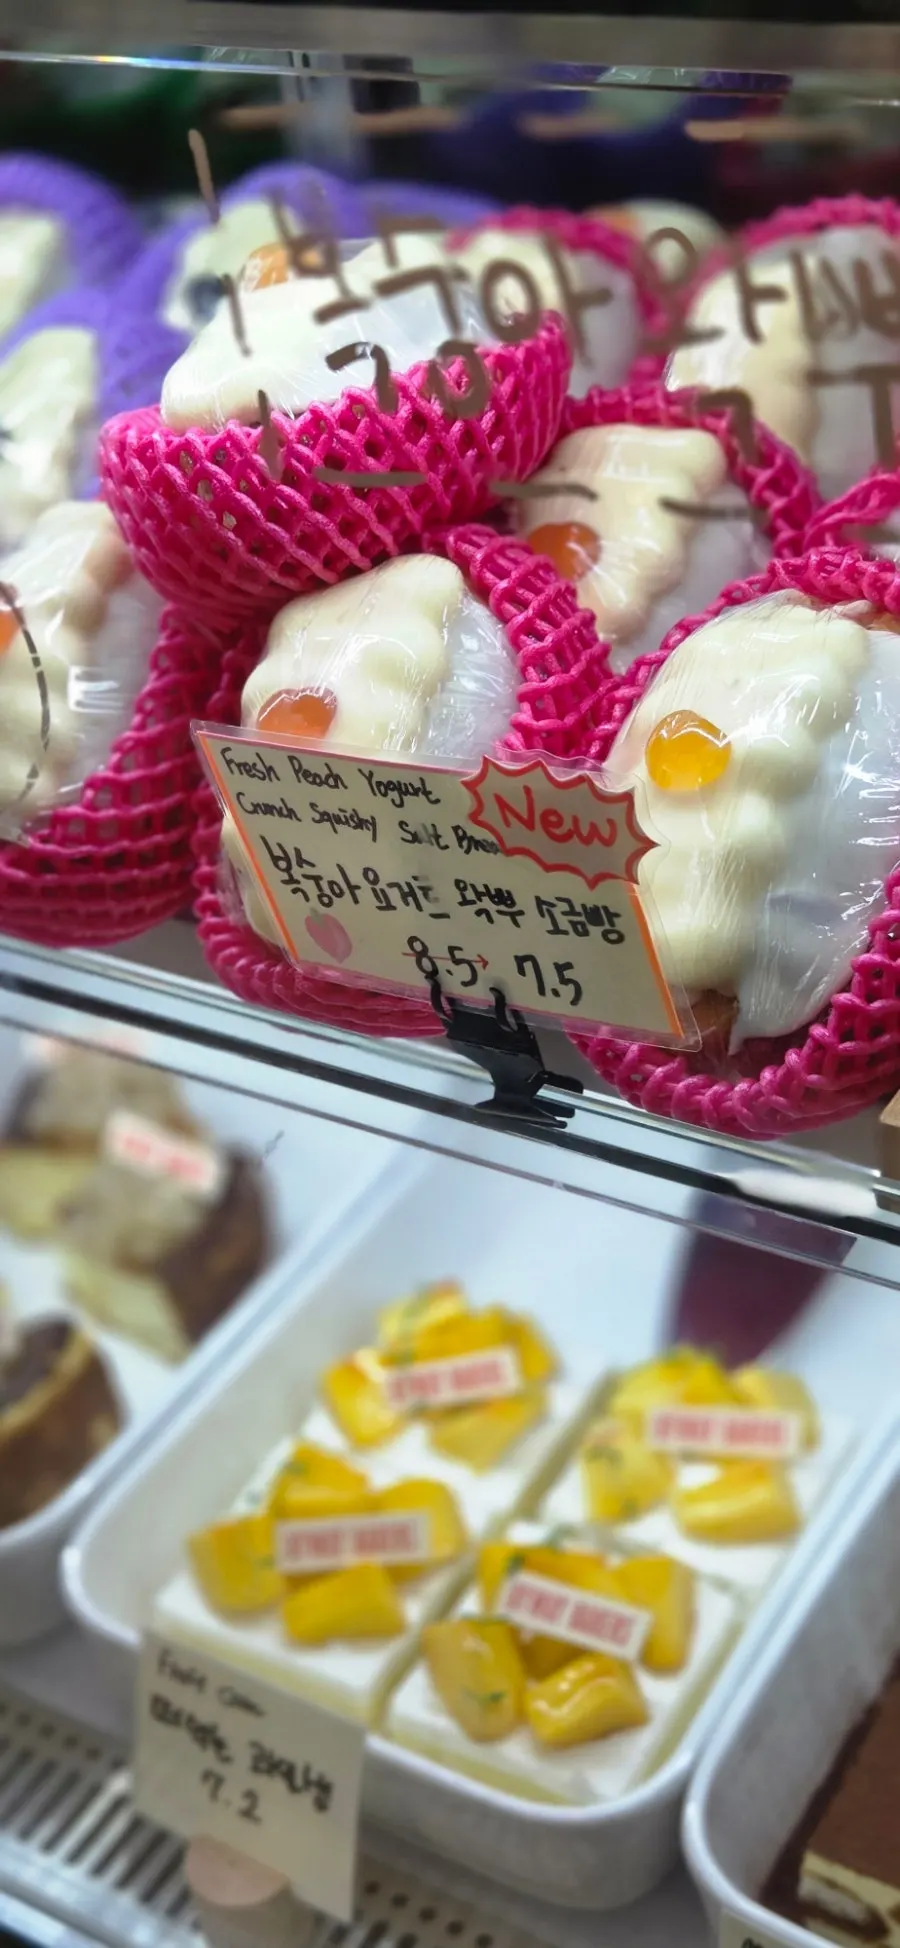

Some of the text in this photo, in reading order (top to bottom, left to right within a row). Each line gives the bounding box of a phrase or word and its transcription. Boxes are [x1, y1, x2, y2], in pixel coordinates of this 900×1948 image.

[220, 747, 441, 808] Fresh Peach Yogurt
[236, 792, 302, 822] Crunch
[309, 802, 377, 842] Squishy
[398, 820, 449, 850] Salt
[494, 785, 618, 847] New
[260, 835, 625, 944] 복숭아 요거트 왁뿌 소금빵
[407, 936, 583, 1006] 8.5 7.5
[202, 1769, 262, 1825] 7.2
